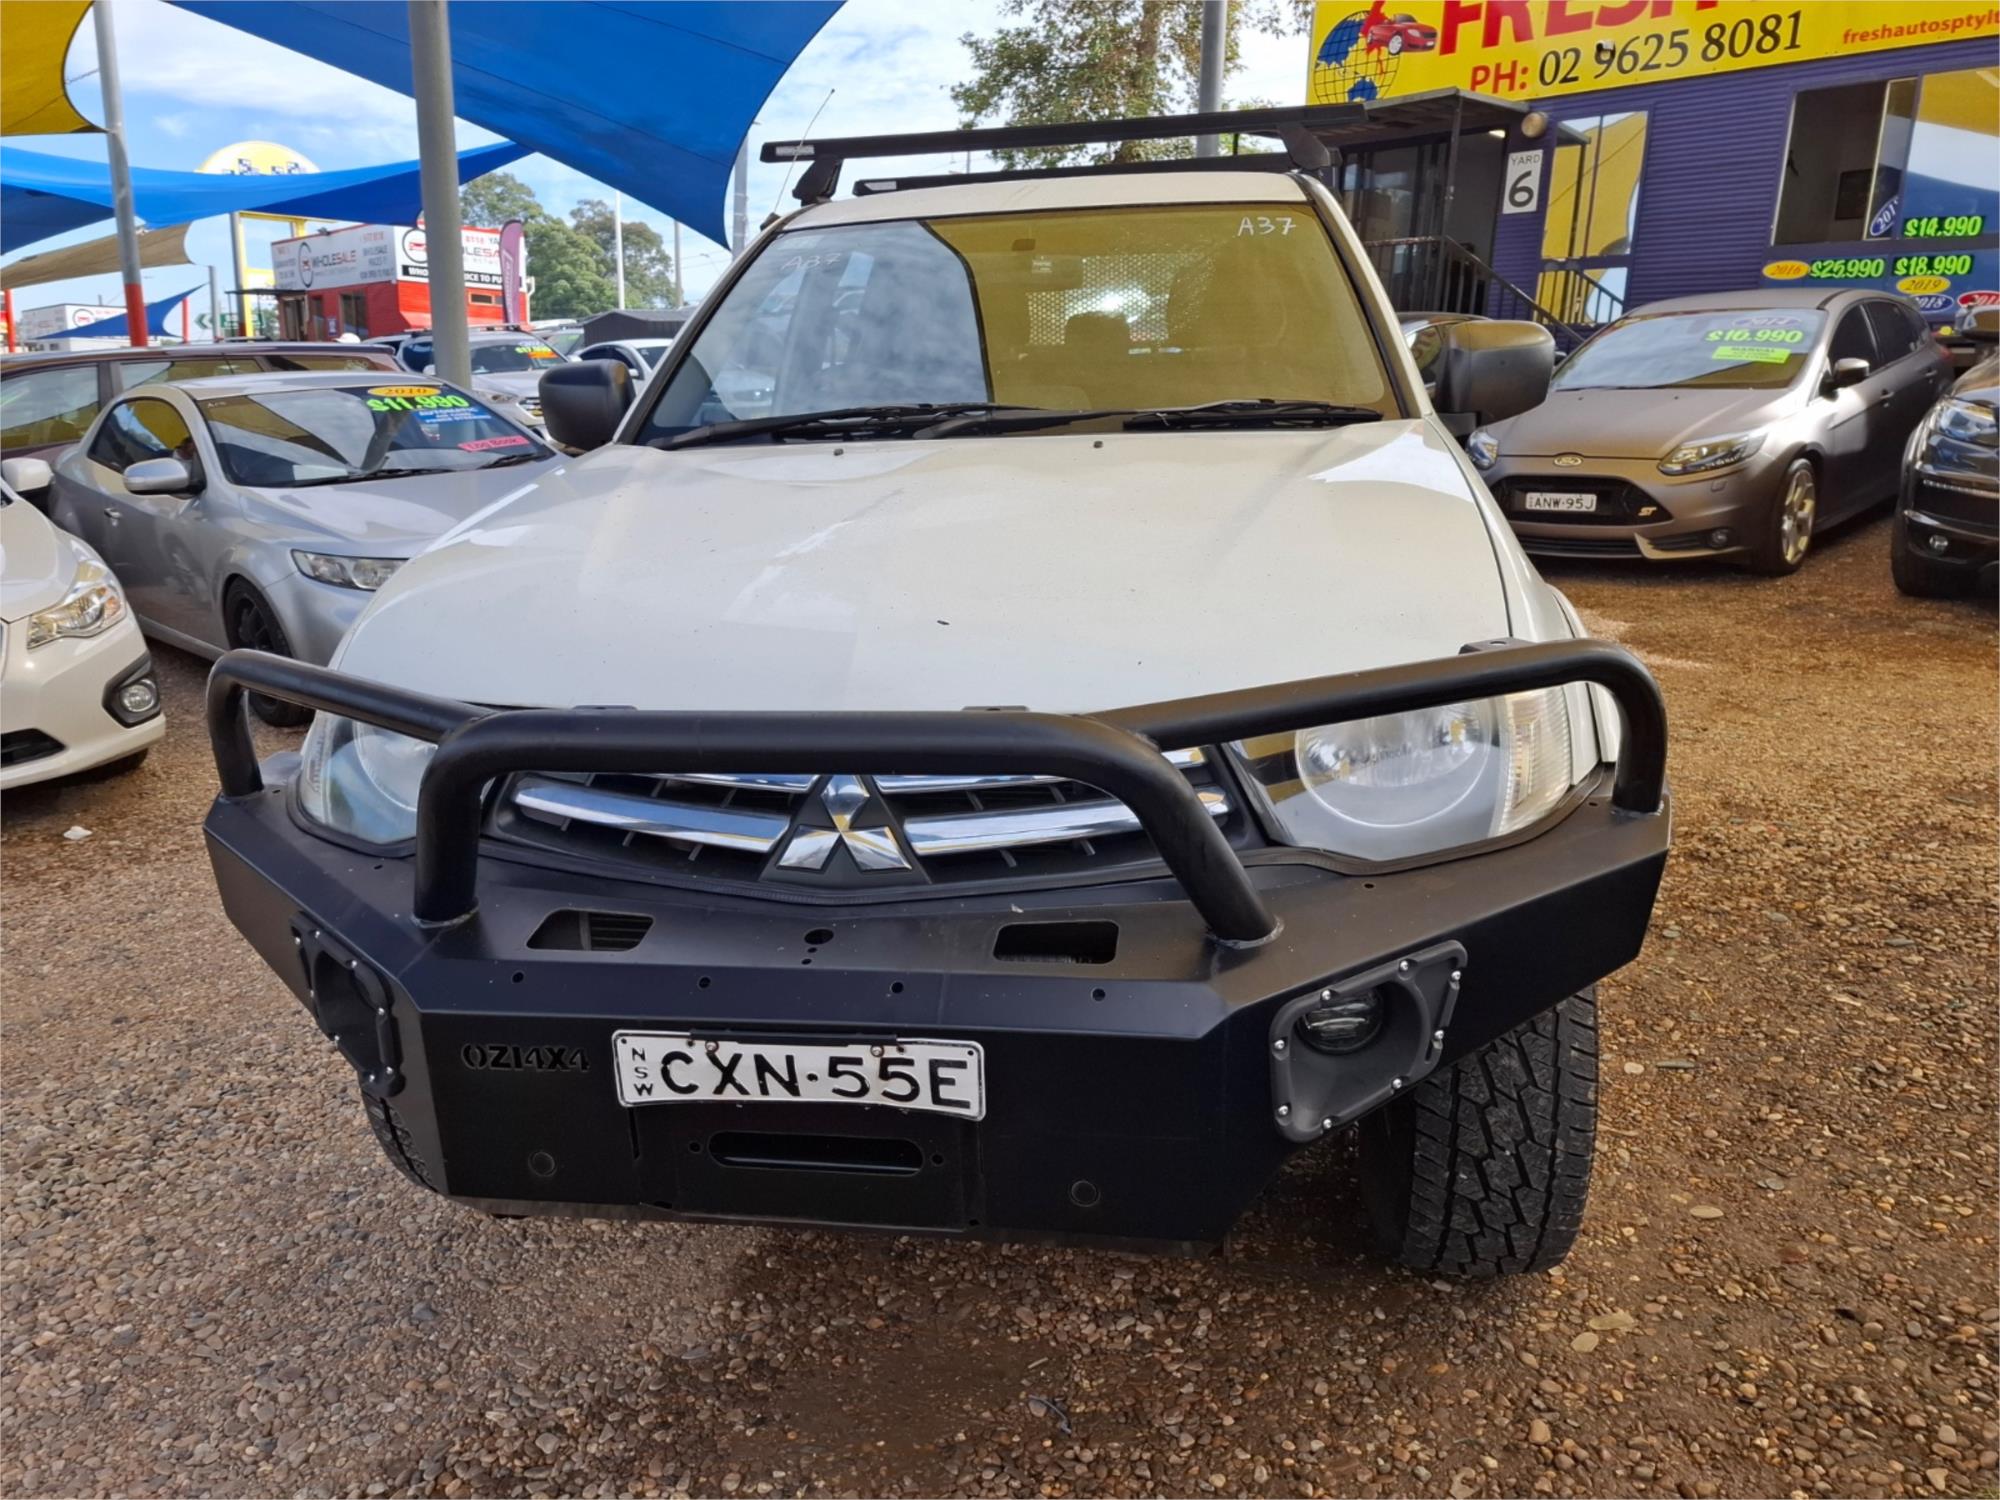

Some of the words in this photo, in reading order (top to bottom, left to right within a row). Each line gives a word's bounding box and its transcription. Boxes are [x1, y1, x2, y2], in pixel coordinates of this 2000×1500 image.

[1439, 0, 1719, 56] FRE
[1470, 60, 1529, 94] PH:
[1539, 47, 1581, 86] 02
[1593, 29, 1690, 79] 9625
[1701, 10, 1802, 62] 8081
[1510, 154, 1541, 166] YARD
[1508, 169, 1534, 208] 6
[1237, 216, 1297, 237] A37
[1904, 216, 1982, 237] $14.990
[1894, 255, 1972, 276] $18.990
[1906, 278, 1941, 292] 2019
